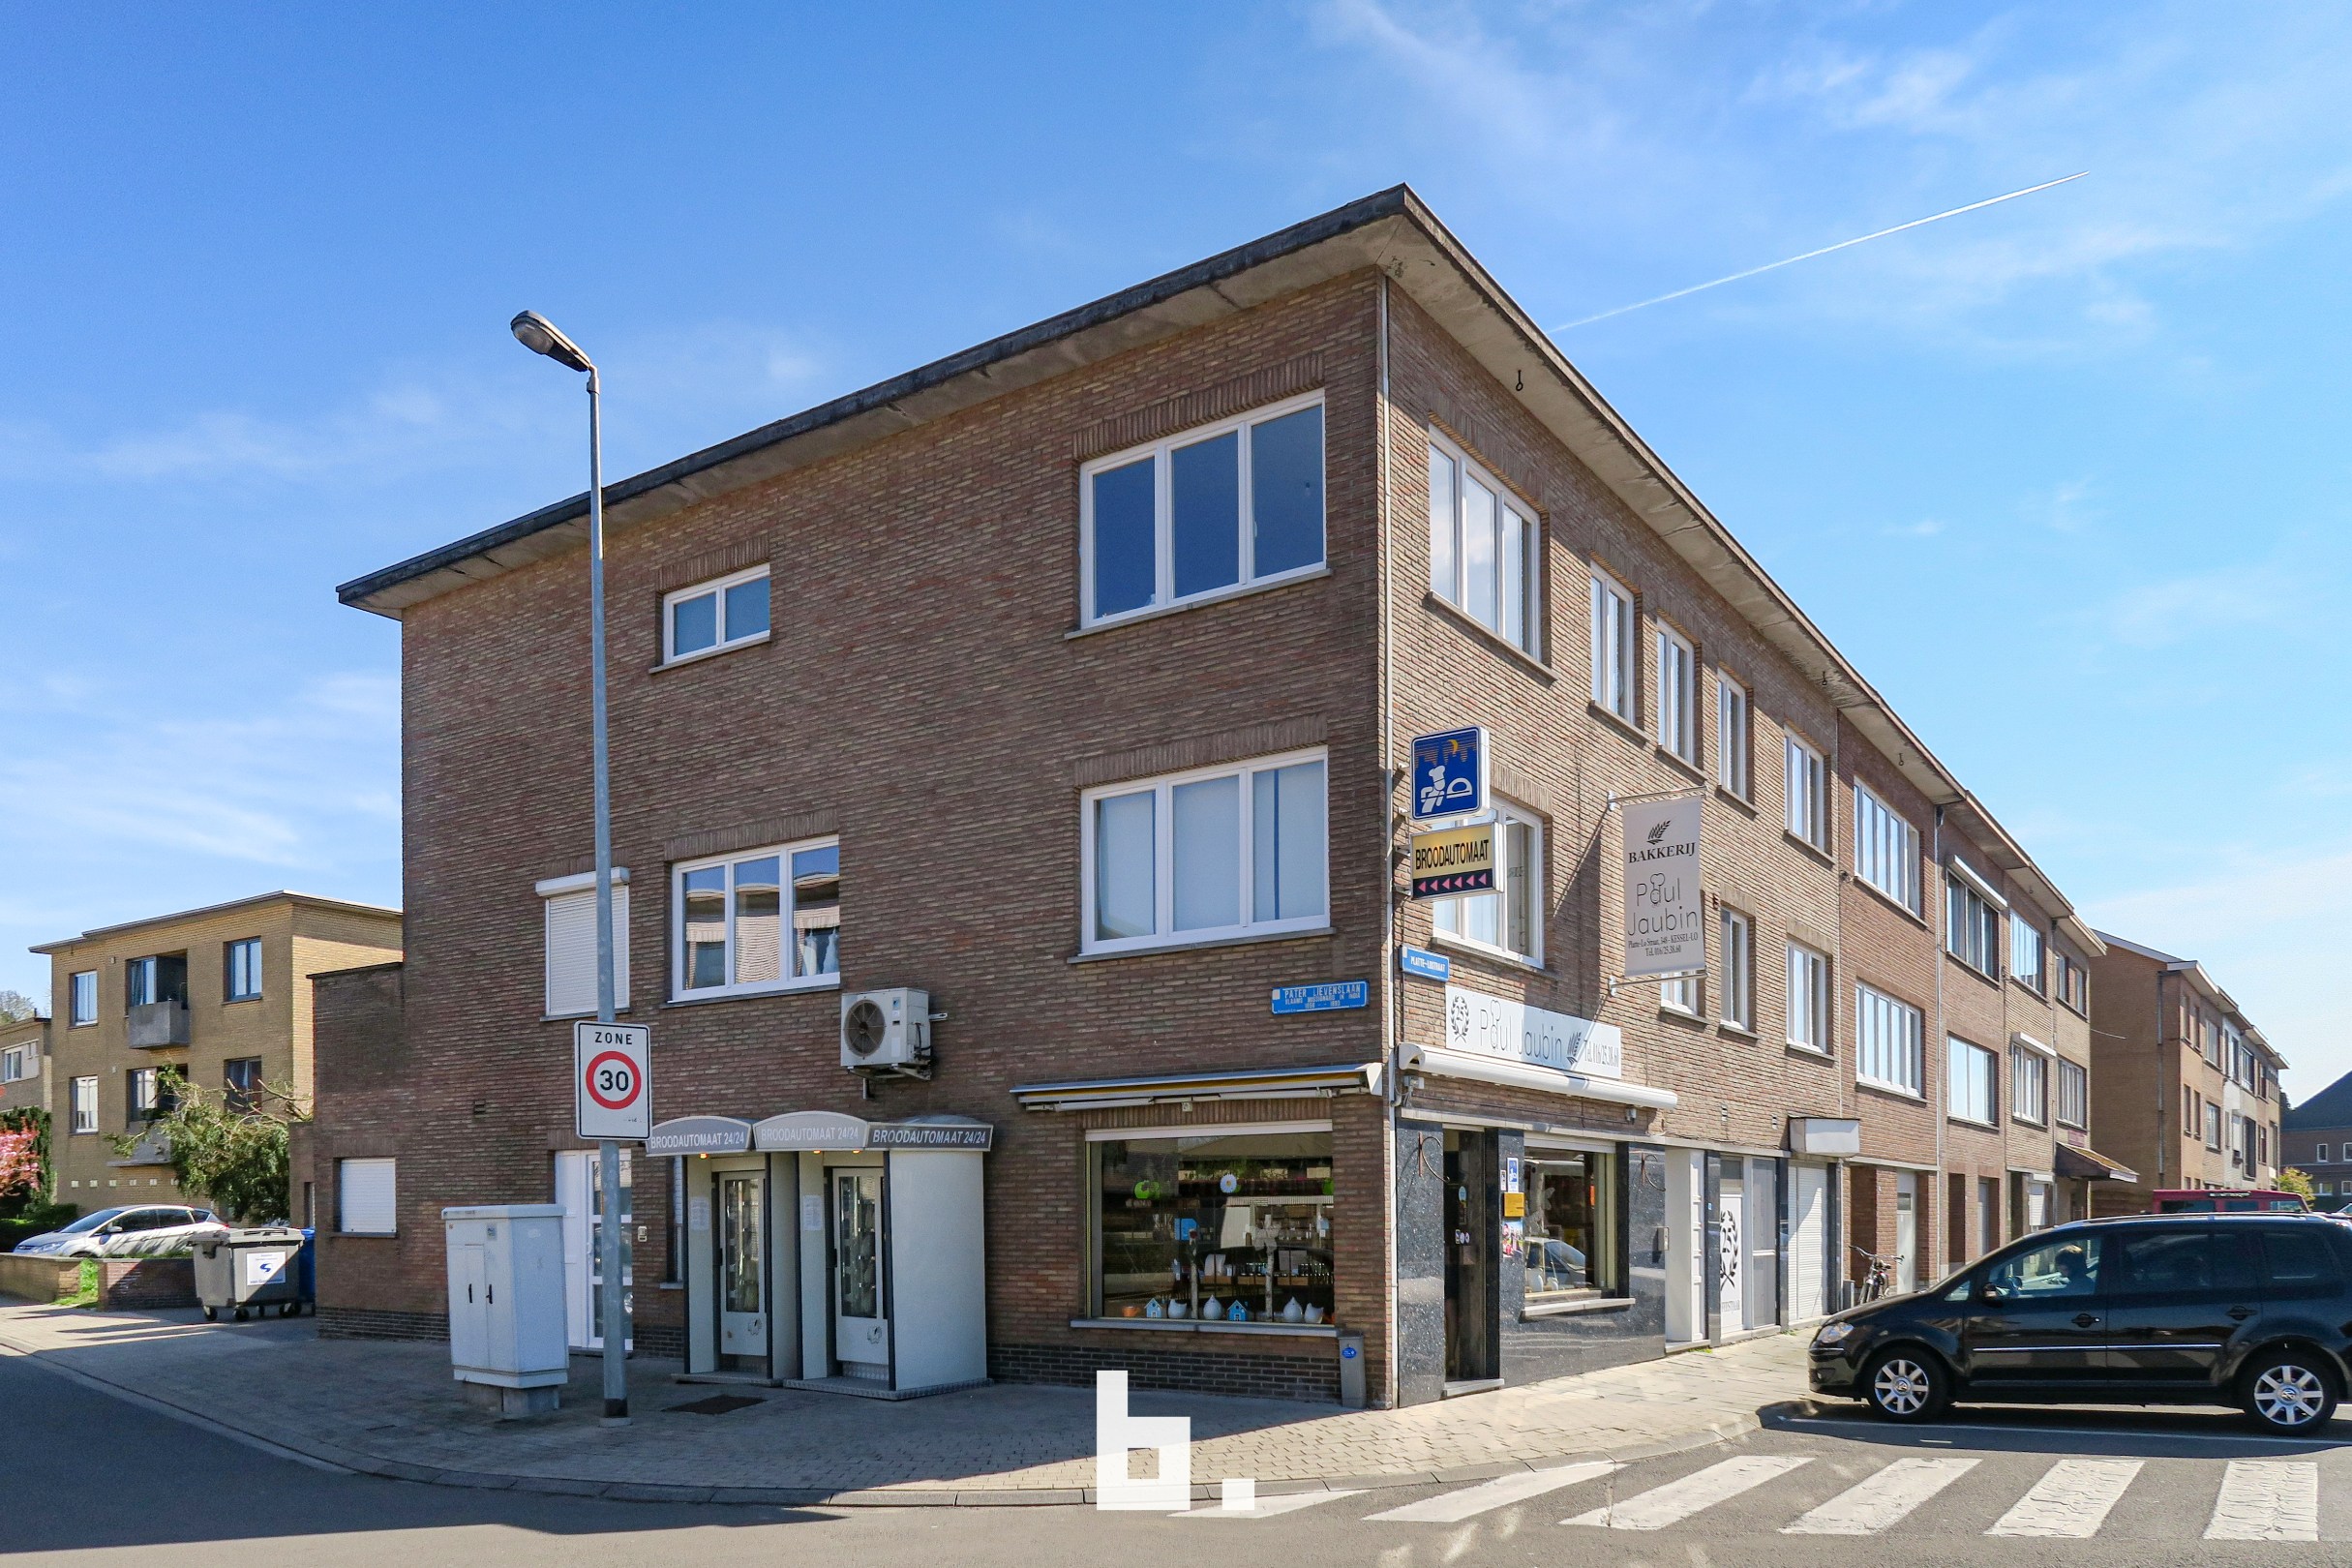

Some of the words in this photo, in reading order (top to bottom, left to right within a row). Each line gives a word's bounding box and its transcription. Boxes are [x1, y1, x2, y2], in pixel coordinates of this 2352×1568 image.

[1415, 839, 1489, 870] BROODAUTOMAAT
[1628, 842, 1697, 864] BAKKERIJ
[1636, 876, 1681, 907] Paul
[1627, 906, 1698, 936] Jaubin
[1671, 932, 1699, 944] KESSEL-LO
[1284, 988, 1307, 998] PATER
[1312, 983, 1361, 997] LIEVENSLAAN
[594, 1031, 633, 1045] ZONE
[1479, 1008, 1512, 1052] Paul
[1517, 1016, 1563, 1063] Jaubin
[599, 1070, 629, 1092] 30
[650, 1132, 723, 1149] BROODAUTOMAAT
[723, 1131, 745, 1145] 24/24
[761, 1127, 836, 1141] BROODAUTOMAAT
[837, 1127, 859, 1140] 24/24
[872, 1129, 963, 1144] BROODAUTOMAAT
[963, 1131, 986, 1144] 24/24
